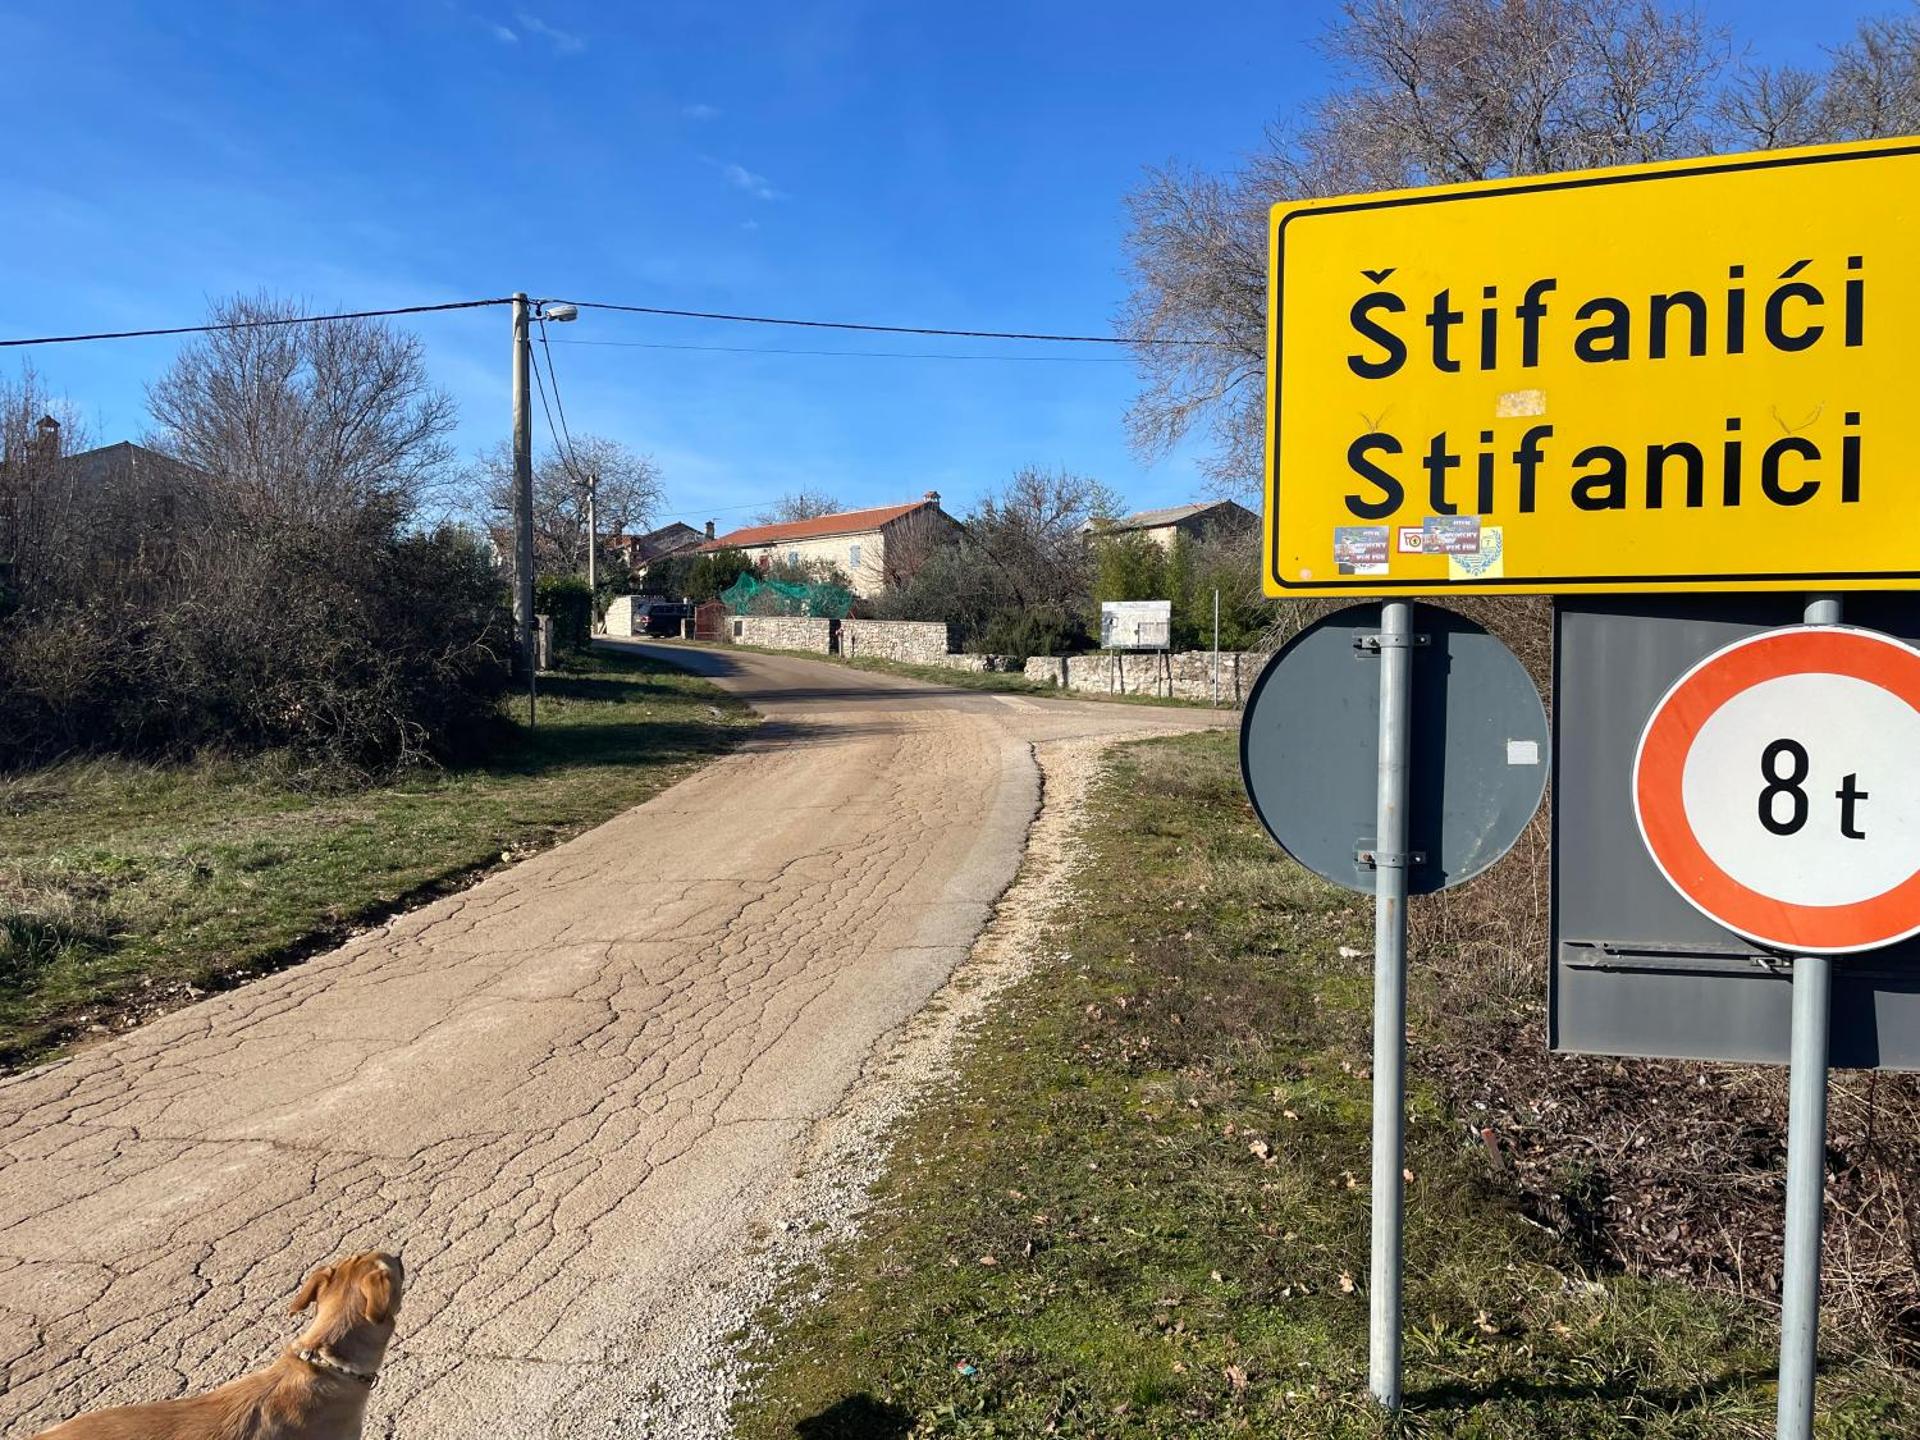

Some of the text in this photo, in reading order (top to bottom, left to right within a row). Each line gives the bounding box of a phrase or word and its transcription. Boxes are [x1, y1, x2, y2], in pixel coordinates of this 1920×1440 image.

[1347, 255, 1864, 380] Štifanići
[1344, 411, 1861, 520] Stifanici
[1758, 738, 1869, 840] 8 t
